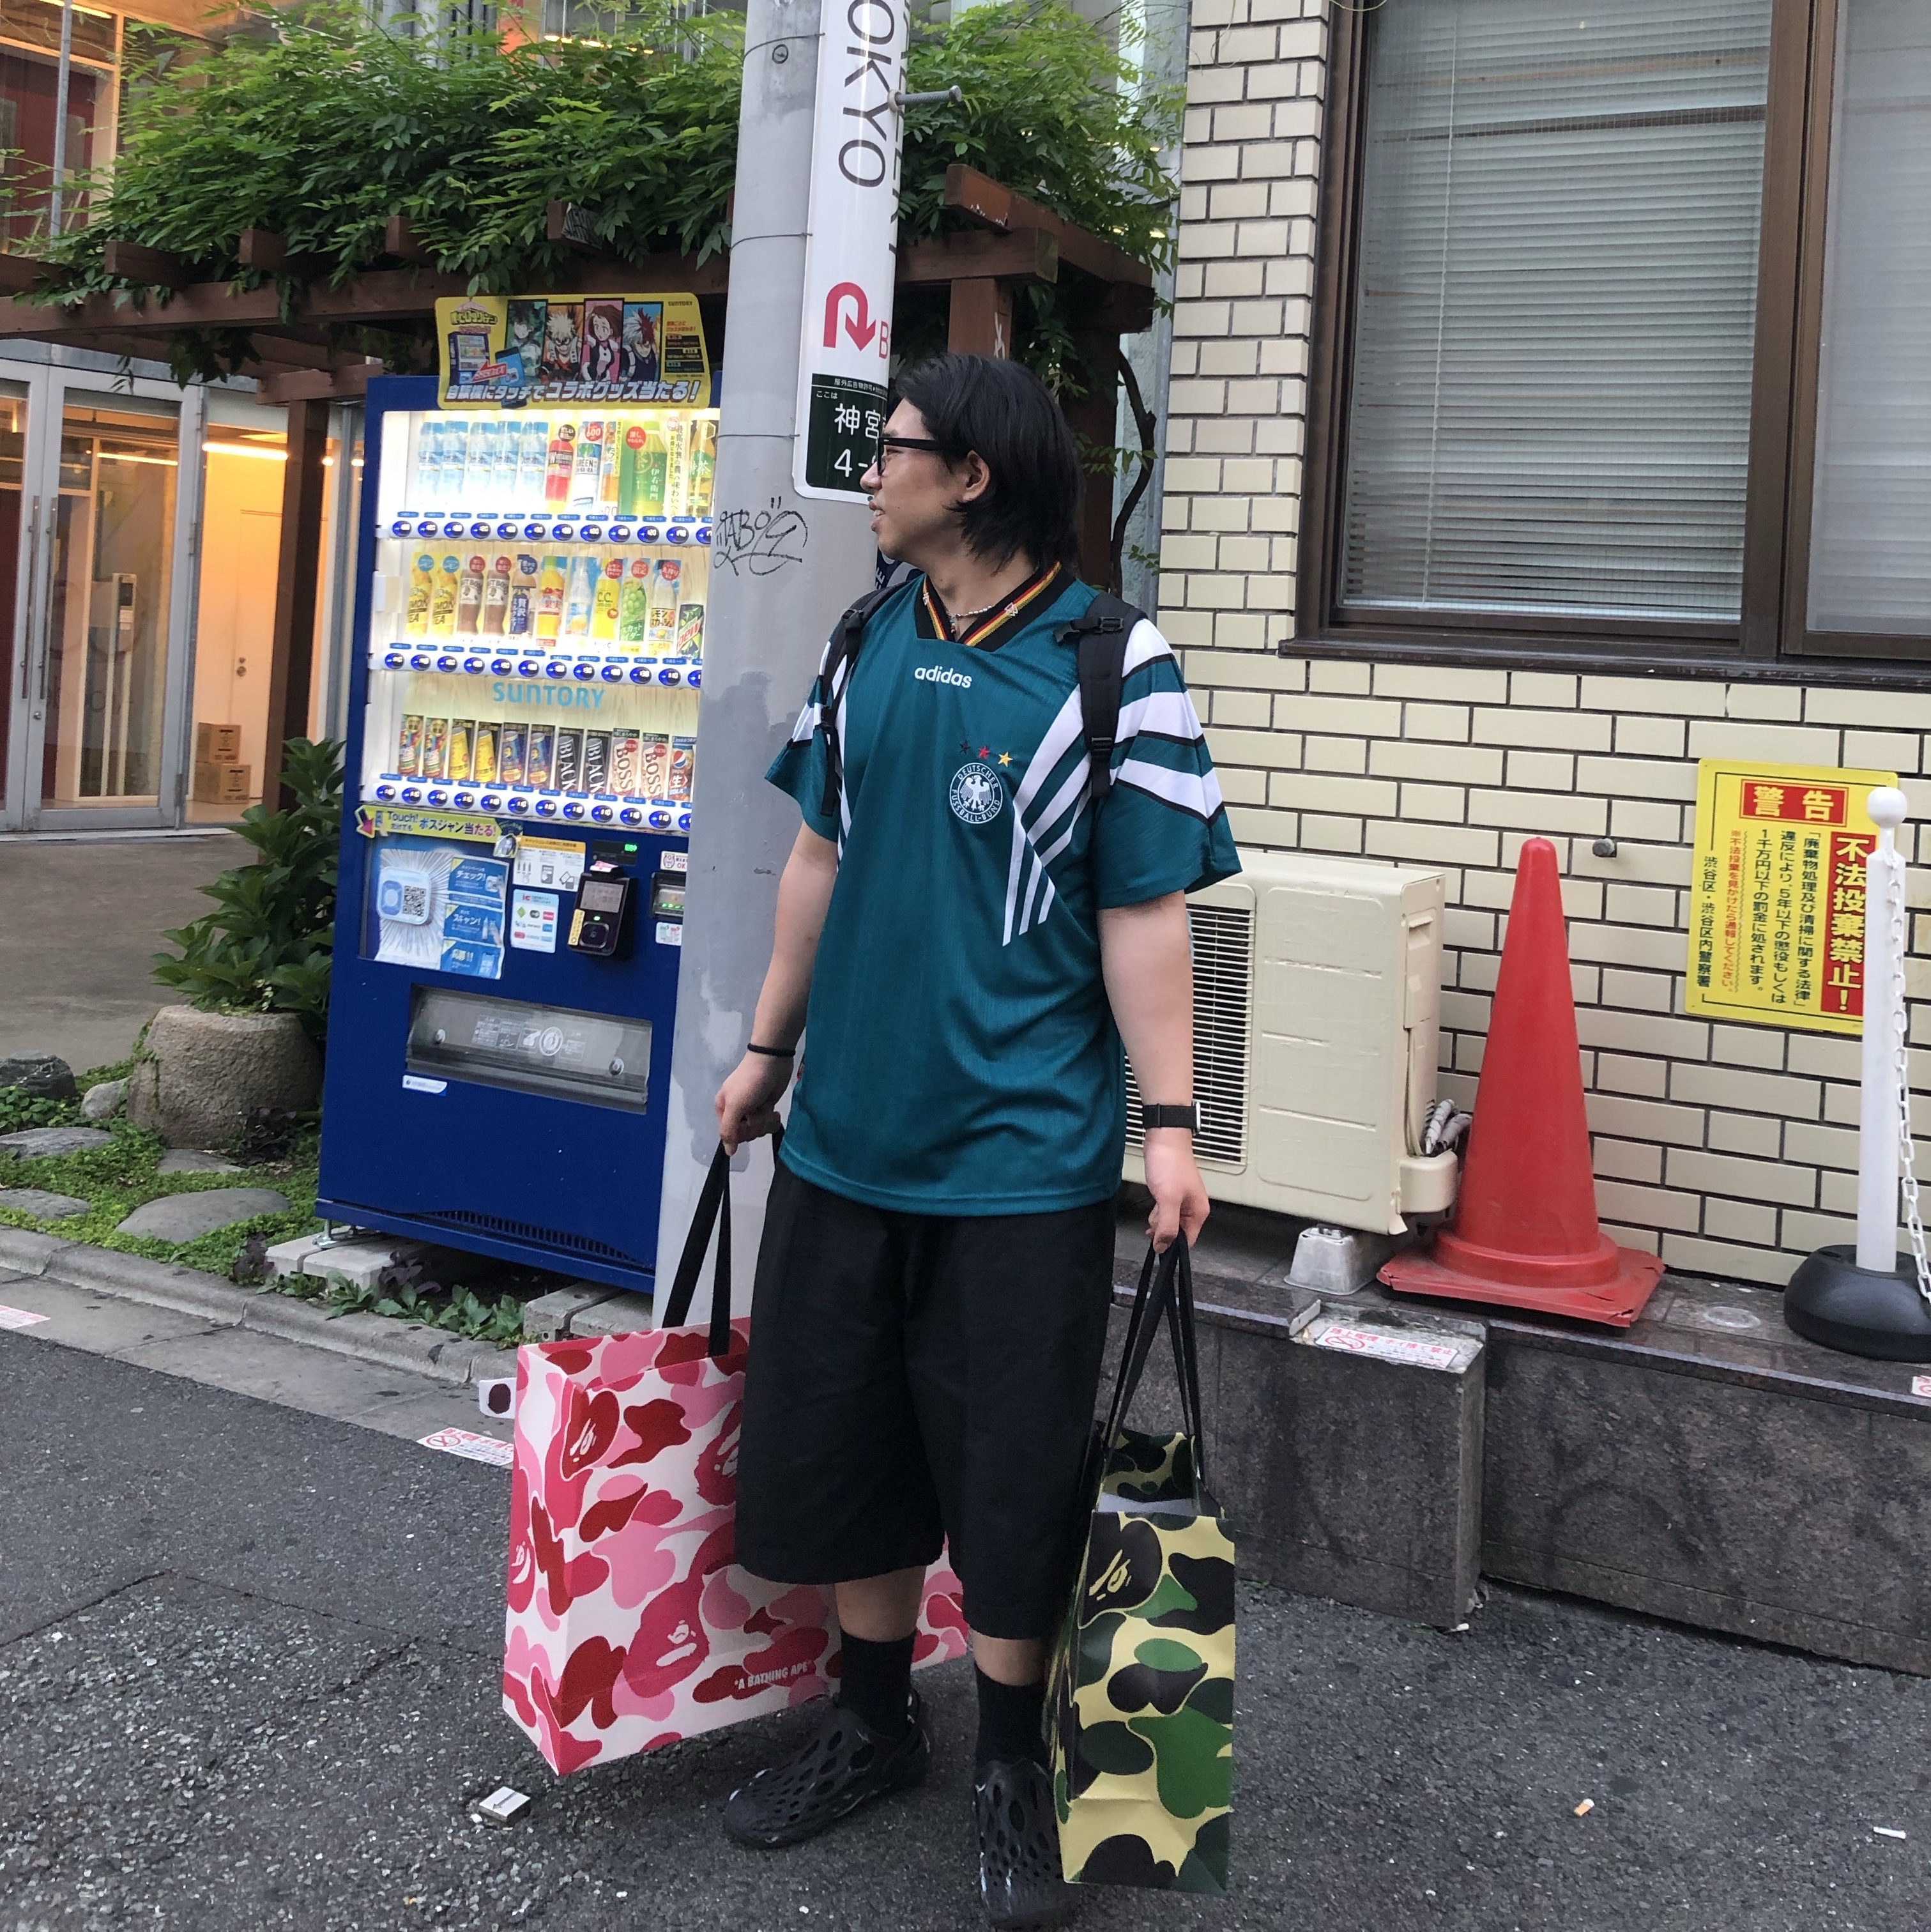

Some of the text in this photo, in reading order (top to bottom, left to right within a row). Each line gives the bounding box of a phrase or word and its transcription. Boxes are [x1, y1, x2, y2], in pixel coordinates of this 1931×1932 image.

[816, 390, 837, 399] ここは
[834, 402, 886, 440] 神宮
[834, 448, 876, 477] 4-
[650, 468, 660, 500] 伊右衛門
[915, 666, 972, 688] adidas
[492, 682, 605, 709] SUNTORY
[559, 743, 576, 790] BLACK
[588, 746, 605, 793] BLACK
[616, 747, 633, 790] BOSS
[645, 753, 662, 795] BOSS
[958, 765, 998, 789] DEUTSCHER
[387, 811, 418, 823] Touch!
[951, 789, 1000, 822] FUSSBALL-BUND
[1753, 786, 1834, 821] 警告
[419, 818, 496, 837] ボスジャン当たる!
[1828, 837, 1870, 1011] 不法投棄禁止！
[747, 1666, 789, 1687] BATHING
